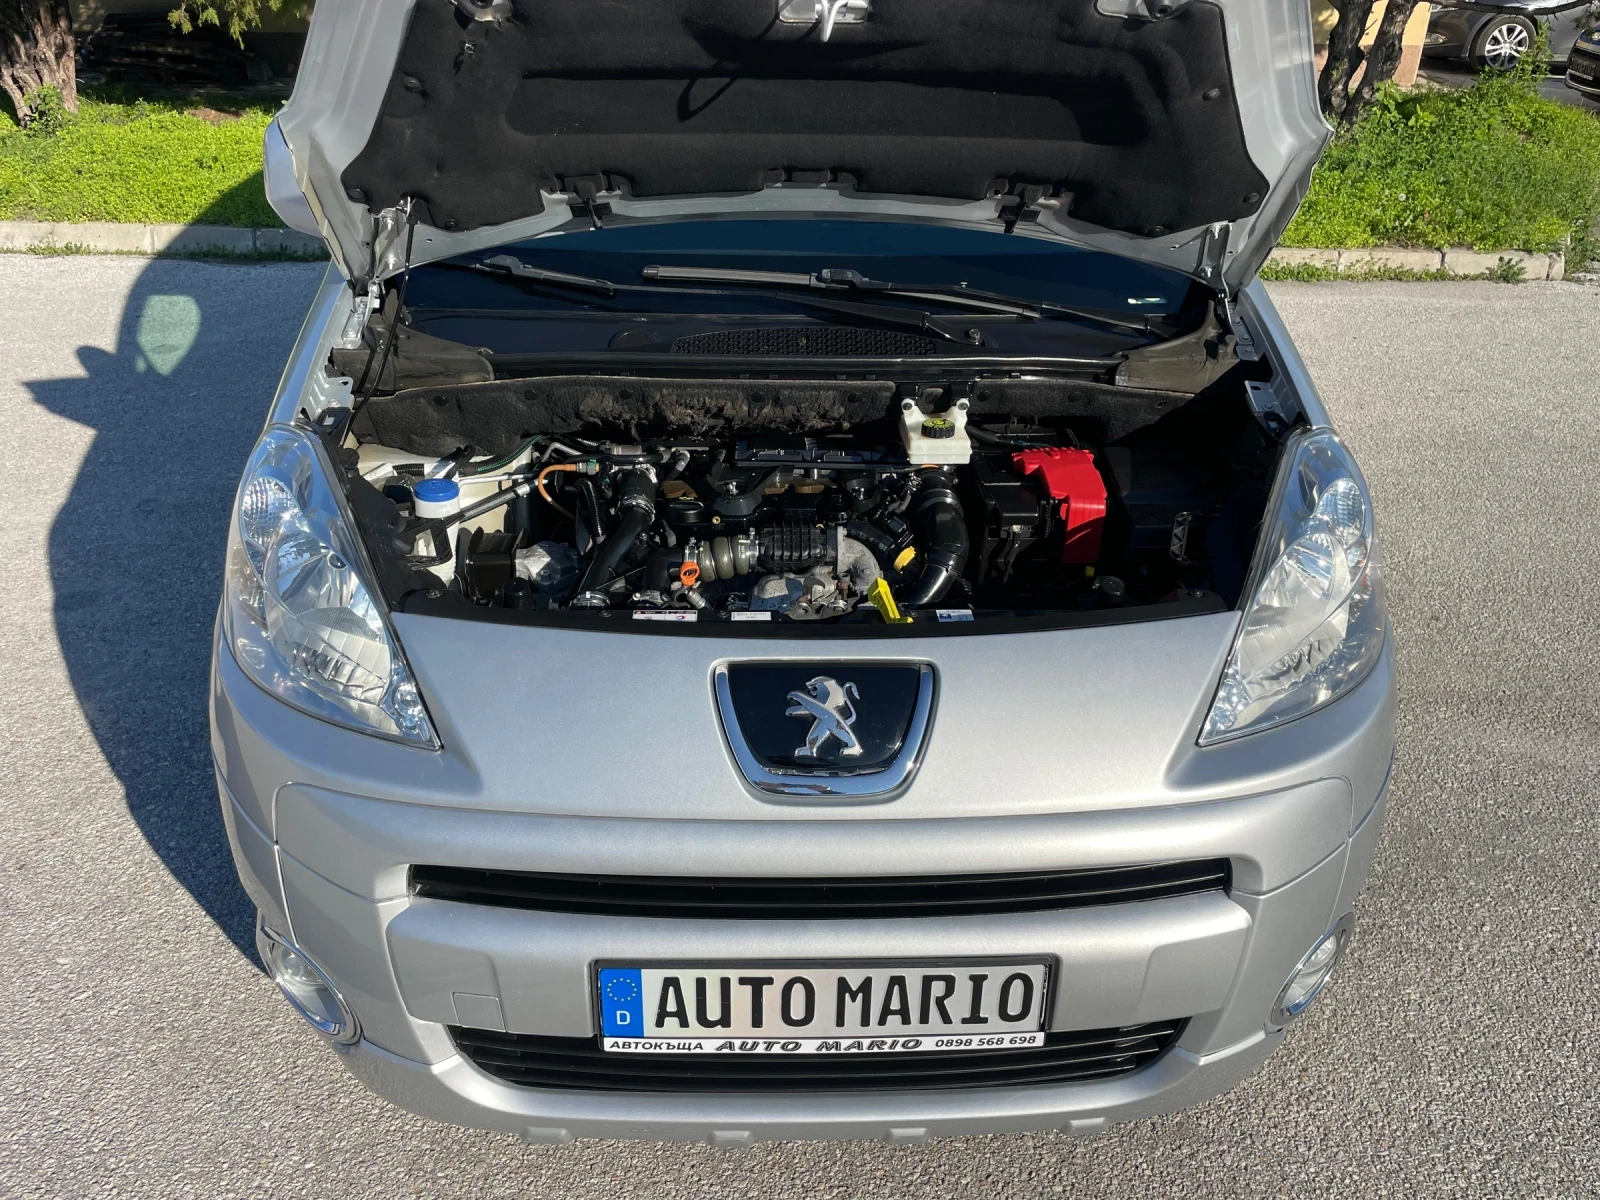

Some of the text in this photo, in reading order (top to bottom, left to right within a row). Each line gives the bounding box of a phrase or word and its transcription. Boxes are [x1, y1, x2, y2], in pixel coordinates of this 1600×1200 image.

[654, 972, 1036, 1029] AUTO MARIO
[616, 1009, 631, 1025] D
[609, 1040, 704, 1051] АВТОКЪЩА
[715, 1038, 923, 1052] AUTO MARIO
[934, 1035, 1037, 1048] 0898 568 698
